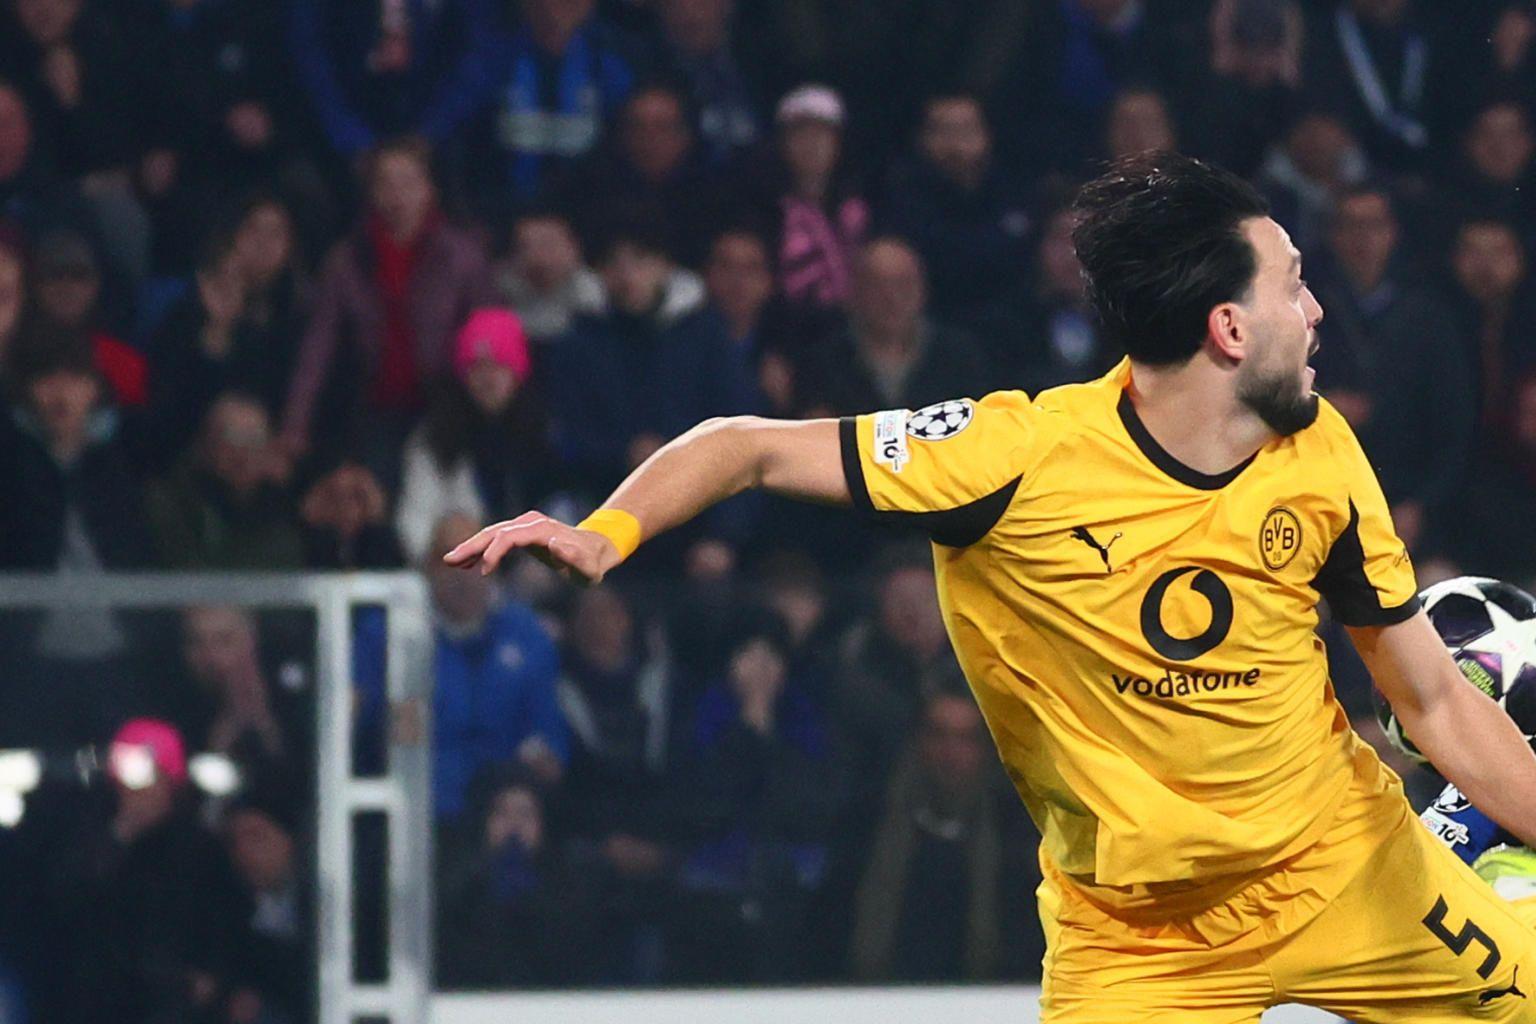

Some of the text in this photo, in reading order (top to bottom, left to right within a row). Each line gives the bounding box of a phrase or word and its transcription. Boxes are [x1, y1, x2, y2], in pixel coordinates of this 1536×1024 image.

[1265, 516, 1295, 552] BVB
[1111, 667, 1261, 698] vodafone
[1421, 892, 1502, 981] 5
